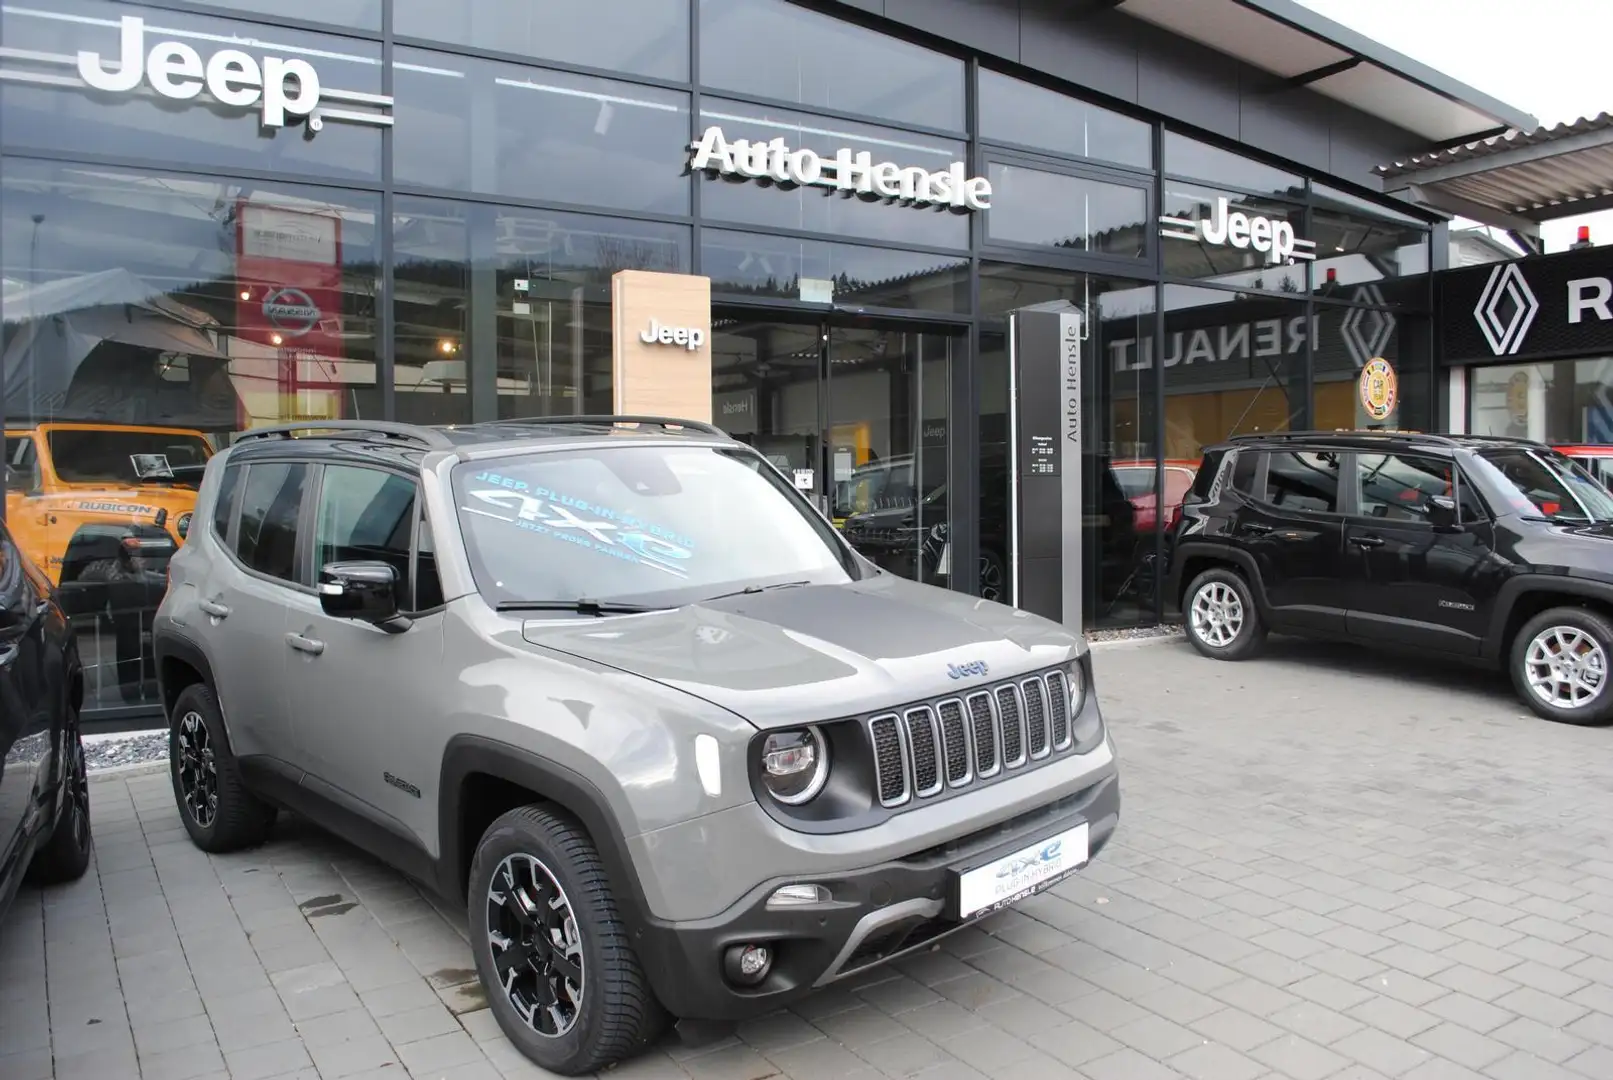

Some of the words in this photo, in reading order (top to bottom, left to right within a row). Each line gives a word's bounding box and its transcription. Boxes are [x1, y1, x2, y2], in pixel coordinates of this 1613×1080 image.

[77, 15, 320, 127] Jeep
[692, 126, 821, 184] Auto
[836, 148, 992, 210] Hensle
[1202, 196, 1295, 264] Jeep
[640, 317, 705, 350] Jeep
[1065, 326, 1077, 390] Hensle
[1066, 398, 1077, 442] Auto
[79, 501, 151, 514] RUBICON
[946, 660, 989, 680] Jeep
